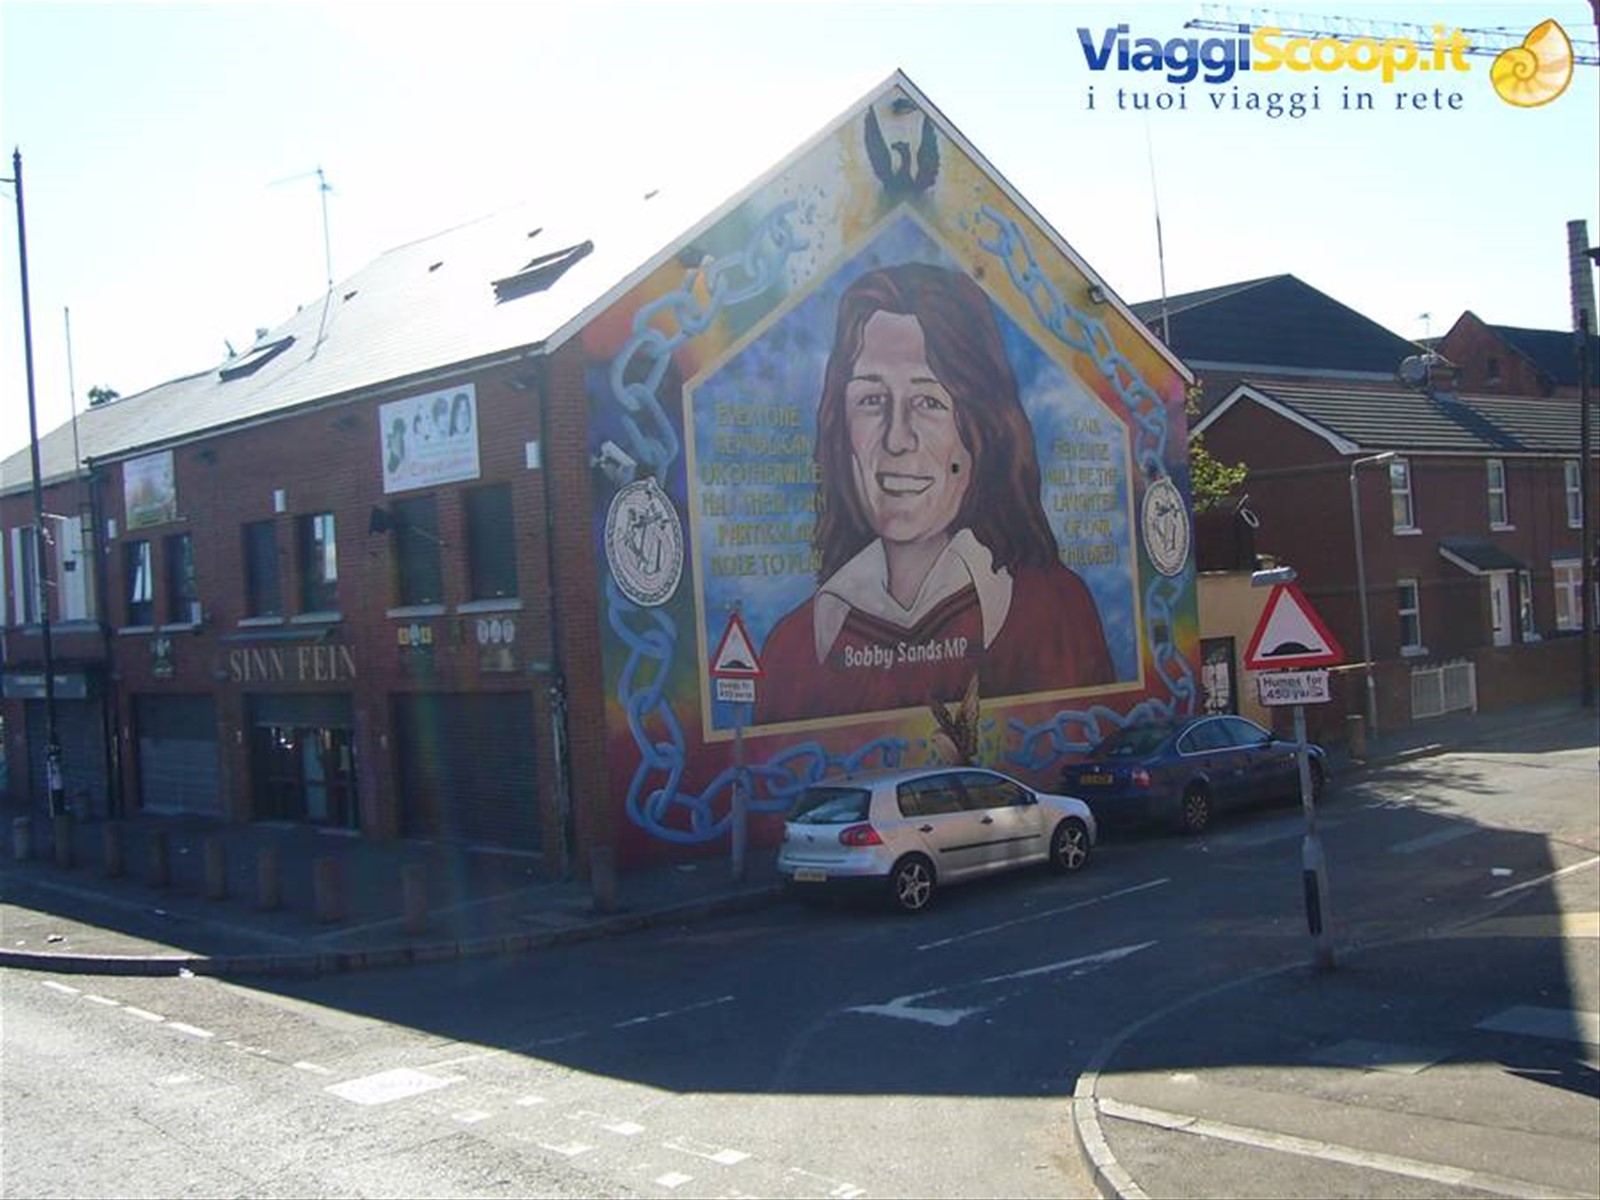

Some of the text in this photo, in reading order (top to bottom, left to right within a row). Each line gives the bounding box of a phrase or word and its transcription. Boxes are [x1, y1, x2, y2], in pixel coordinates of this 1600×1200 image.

[229, 648, 285, 682] SINN
[844, 637, 968, 669] Bobby Sands MP
